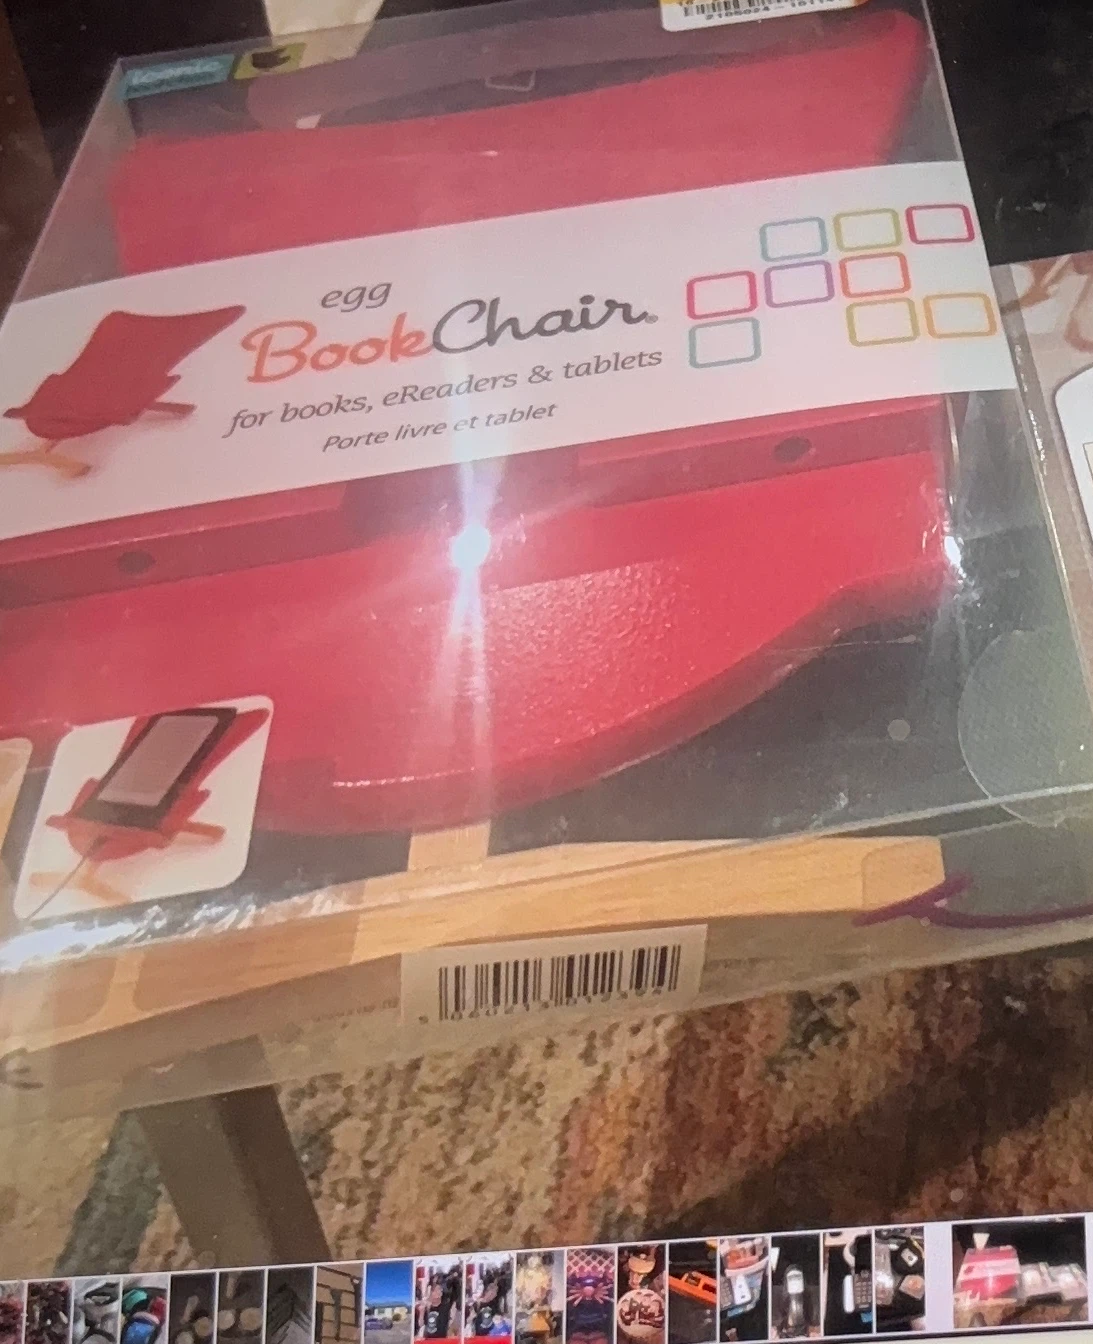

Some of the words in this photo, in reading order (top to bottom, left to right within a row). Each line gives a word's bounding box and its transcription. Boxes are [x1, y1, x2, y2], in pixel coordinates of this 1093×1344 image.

[321, 282, 392, 313] egg
[221, 409, 273, 439] for
[280, 395, 373, 423] books,
[383, 373, 518, 407] eReaders
[527, 364, 553, 384] &
[563, 351, 662, 379] tablets
[322, 431, 389, 453] Porte
[395, 421, 448, 441] livre
[453, 415, 479, 432] et
[485, 403, 558, 427] tablet
